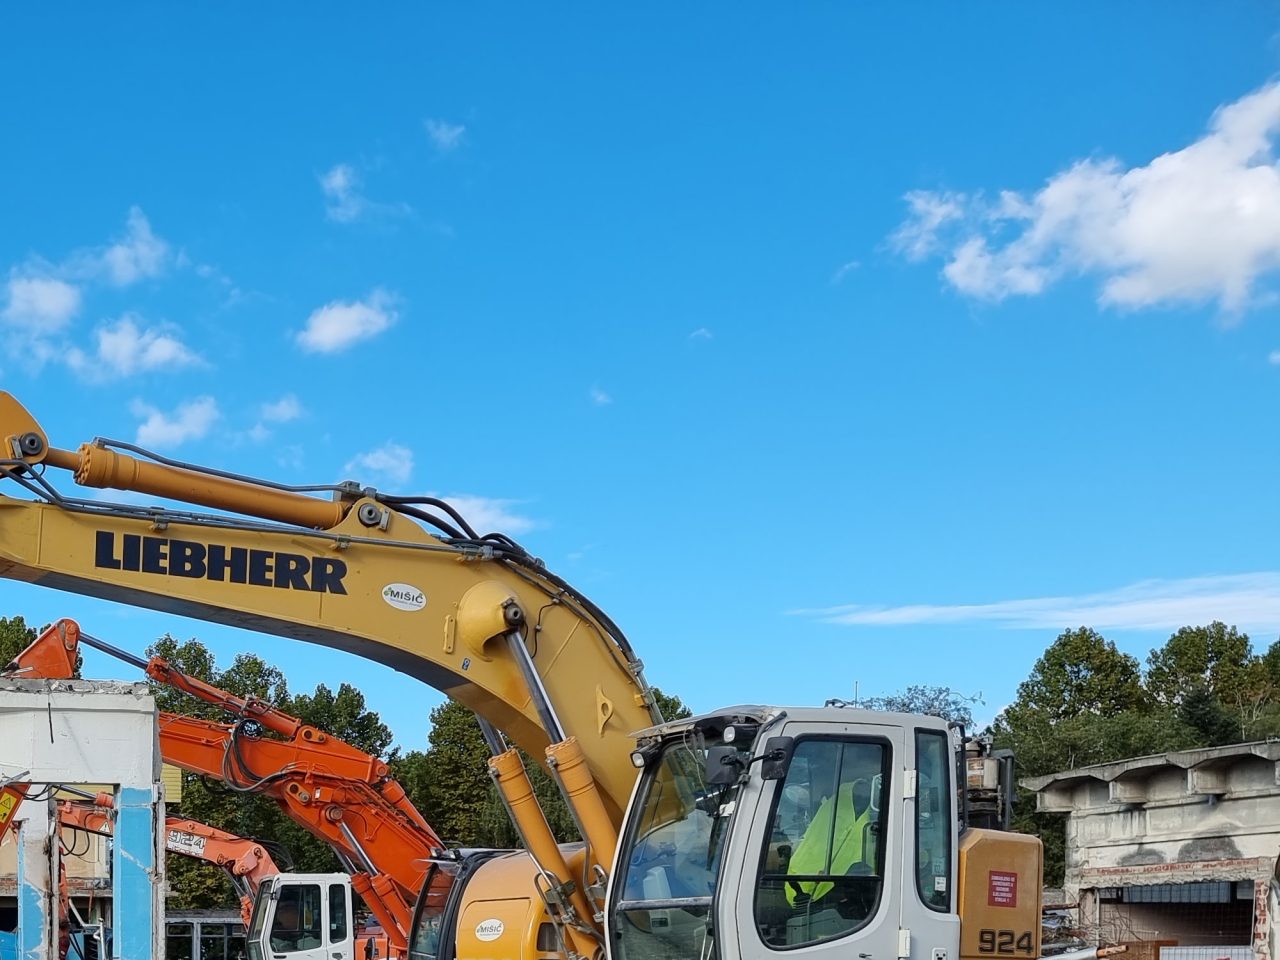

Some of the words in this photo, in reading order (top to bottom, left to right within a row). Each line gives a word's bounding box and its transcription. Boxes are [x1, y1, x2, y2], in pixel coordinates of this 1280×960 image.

[95, 530, 348, 595] LIEBHERR
[169, 830, 206, 849] 924
[979, 929, 1034, 955] 924
